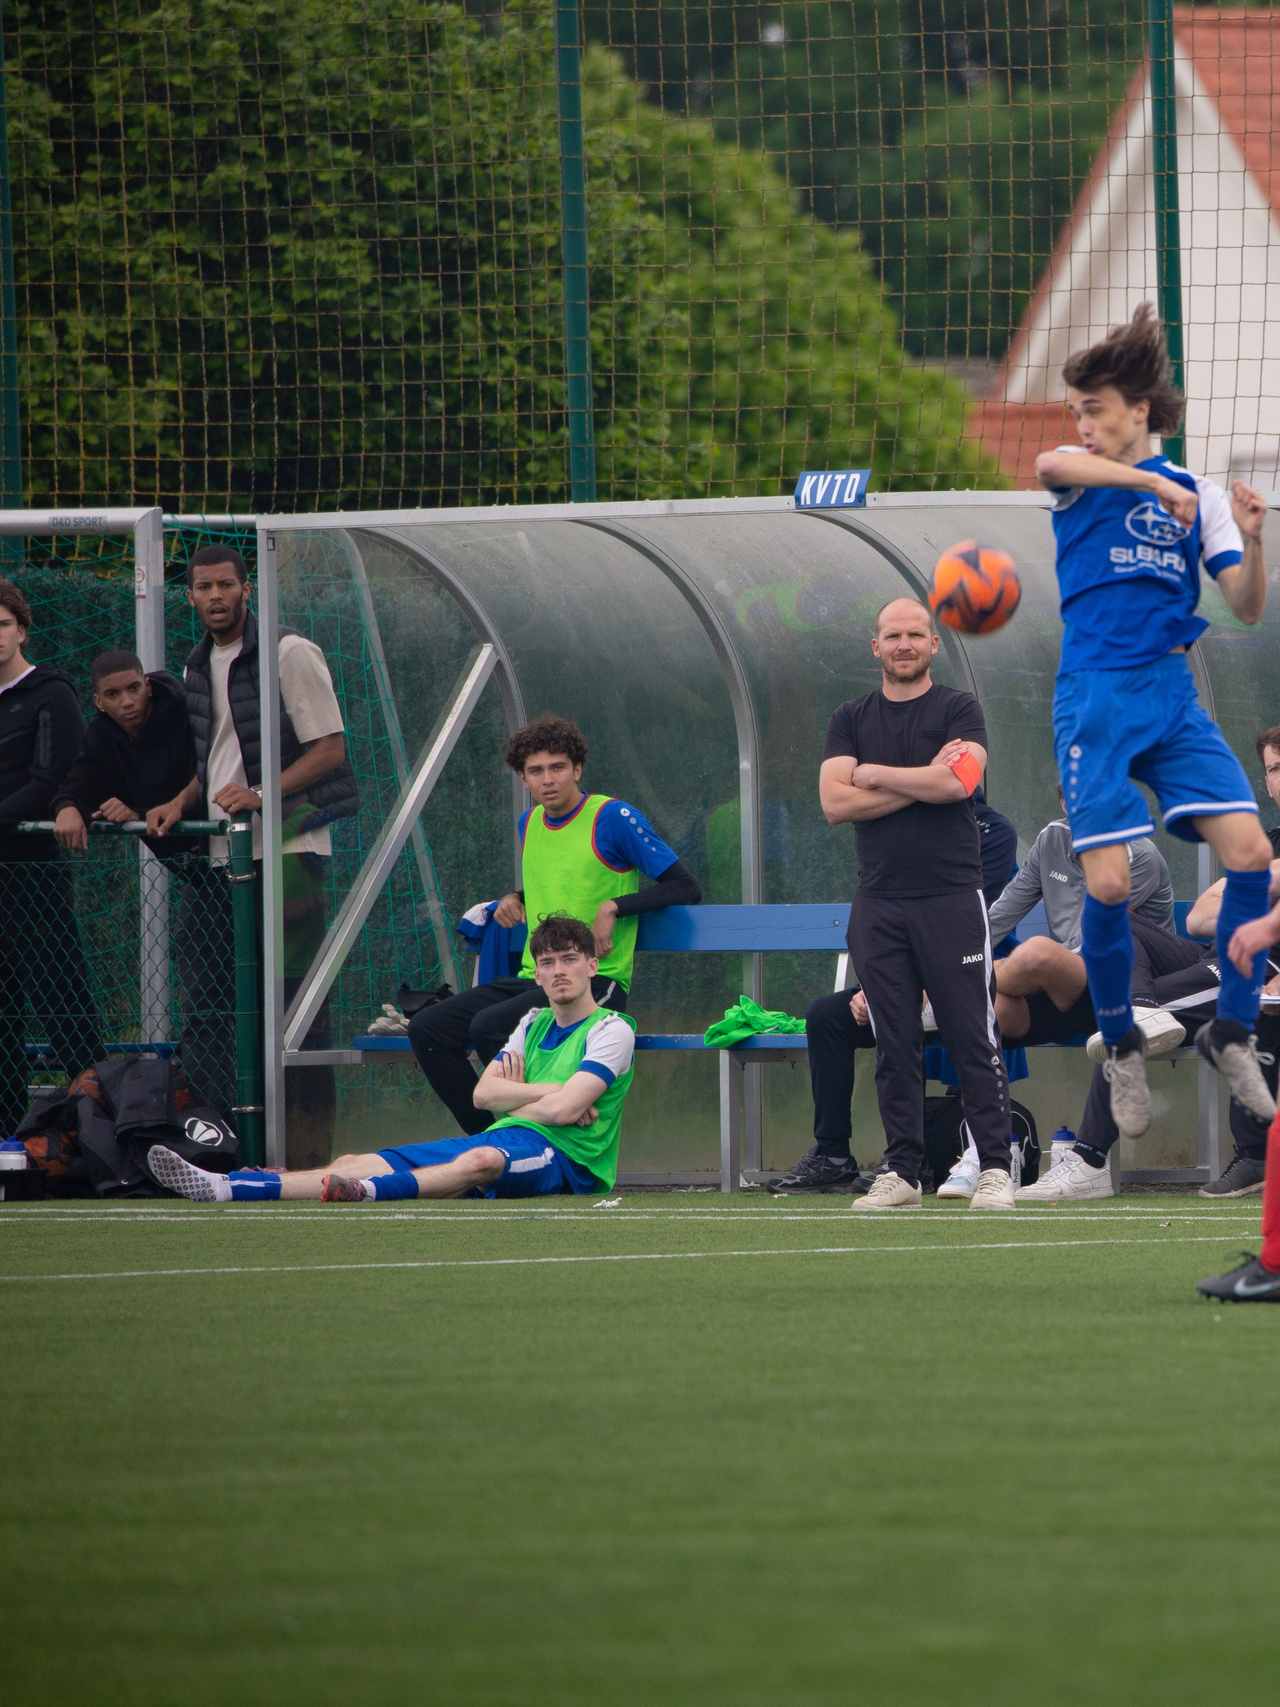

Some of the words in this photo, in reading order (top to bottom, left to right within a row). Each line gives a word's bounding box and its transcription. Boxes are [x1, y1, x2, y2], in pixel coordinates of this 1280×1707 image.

[800, 472, 861, 506] KVTD
[52, 517, 71, 527] D&D
[73, 516, 103, 527] SPORT
[1048, 870, 1068, 883] JAKO
[961, 953, 984, 965] JAKO
